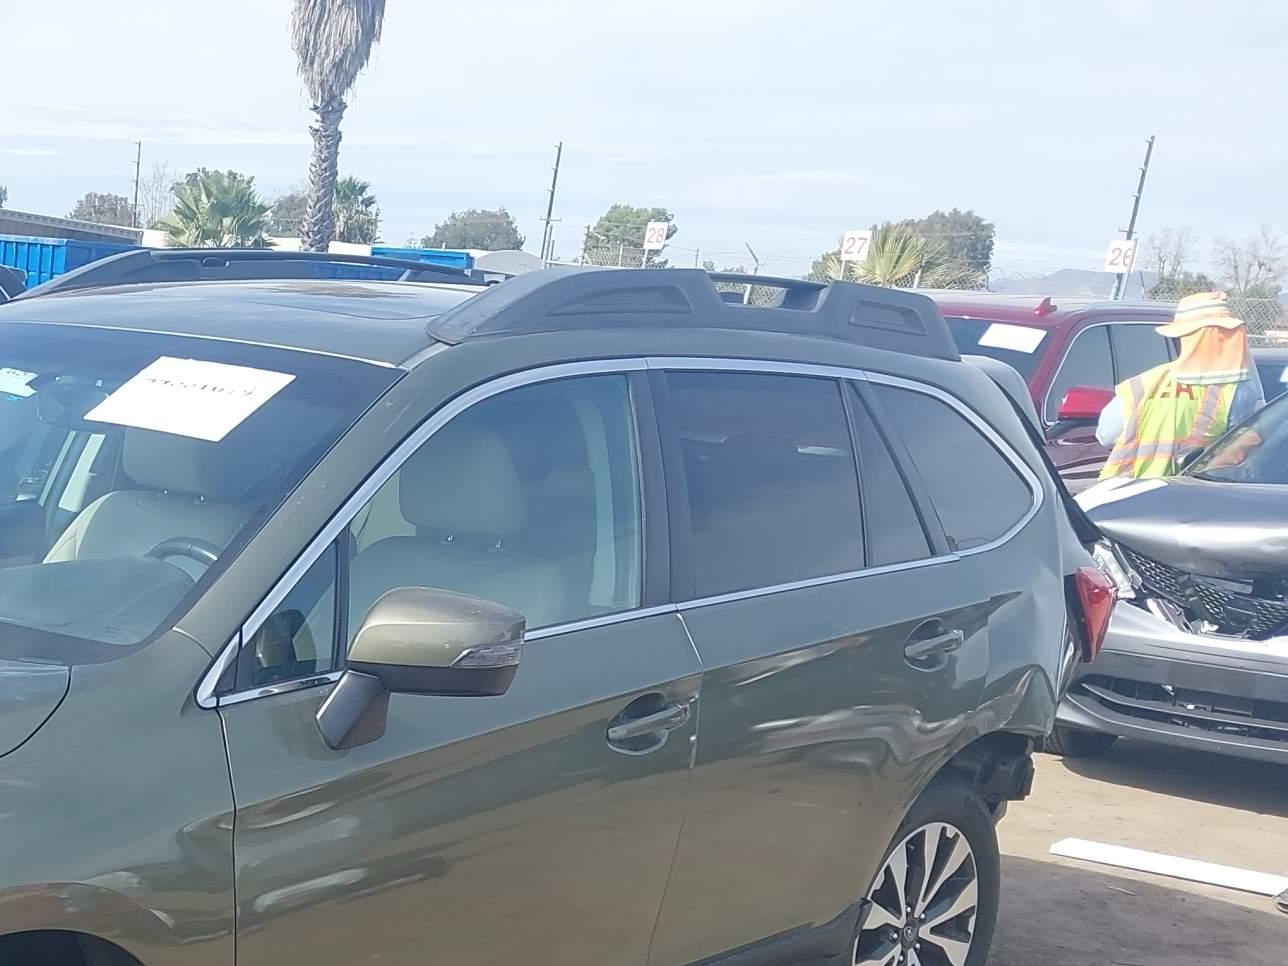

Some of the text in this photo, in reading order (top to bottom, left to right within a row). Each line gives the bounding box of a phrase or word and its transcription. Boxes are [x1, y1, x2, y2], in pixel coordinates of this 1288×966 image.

[646, 227, 665, 243] 28
[844, 237, 869, 255] 27
[1108, 247, 1133, 267] 26
